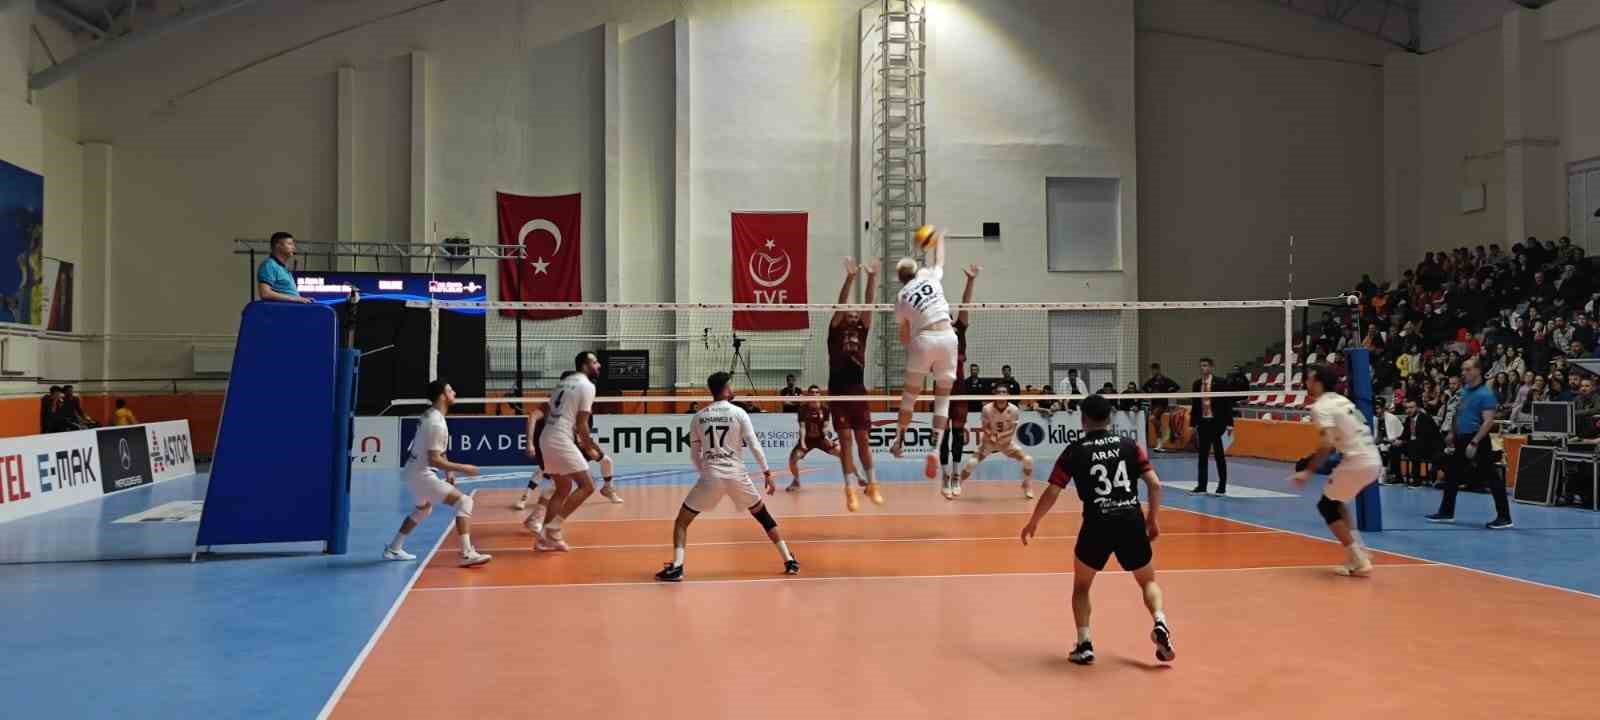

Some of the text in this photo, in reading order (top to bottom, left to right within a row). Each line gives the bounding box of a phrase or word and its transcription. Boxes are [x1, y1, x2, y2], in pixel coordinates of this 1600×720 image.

[753, 290, 788, 305] TVF
[591, 427, 692, 454] -MAK
[704, 425, 730, 449] 17
[869, 427, 937, 447] SPOR
[1048, 425, 1083, 445] kiler
[163, 434, 191, 467] ASTOR
[1091, 448, 1121, 461] ARAY
[37, 446, 97, 493] E-MAK
[1089, 460, 1132, 496] 34
